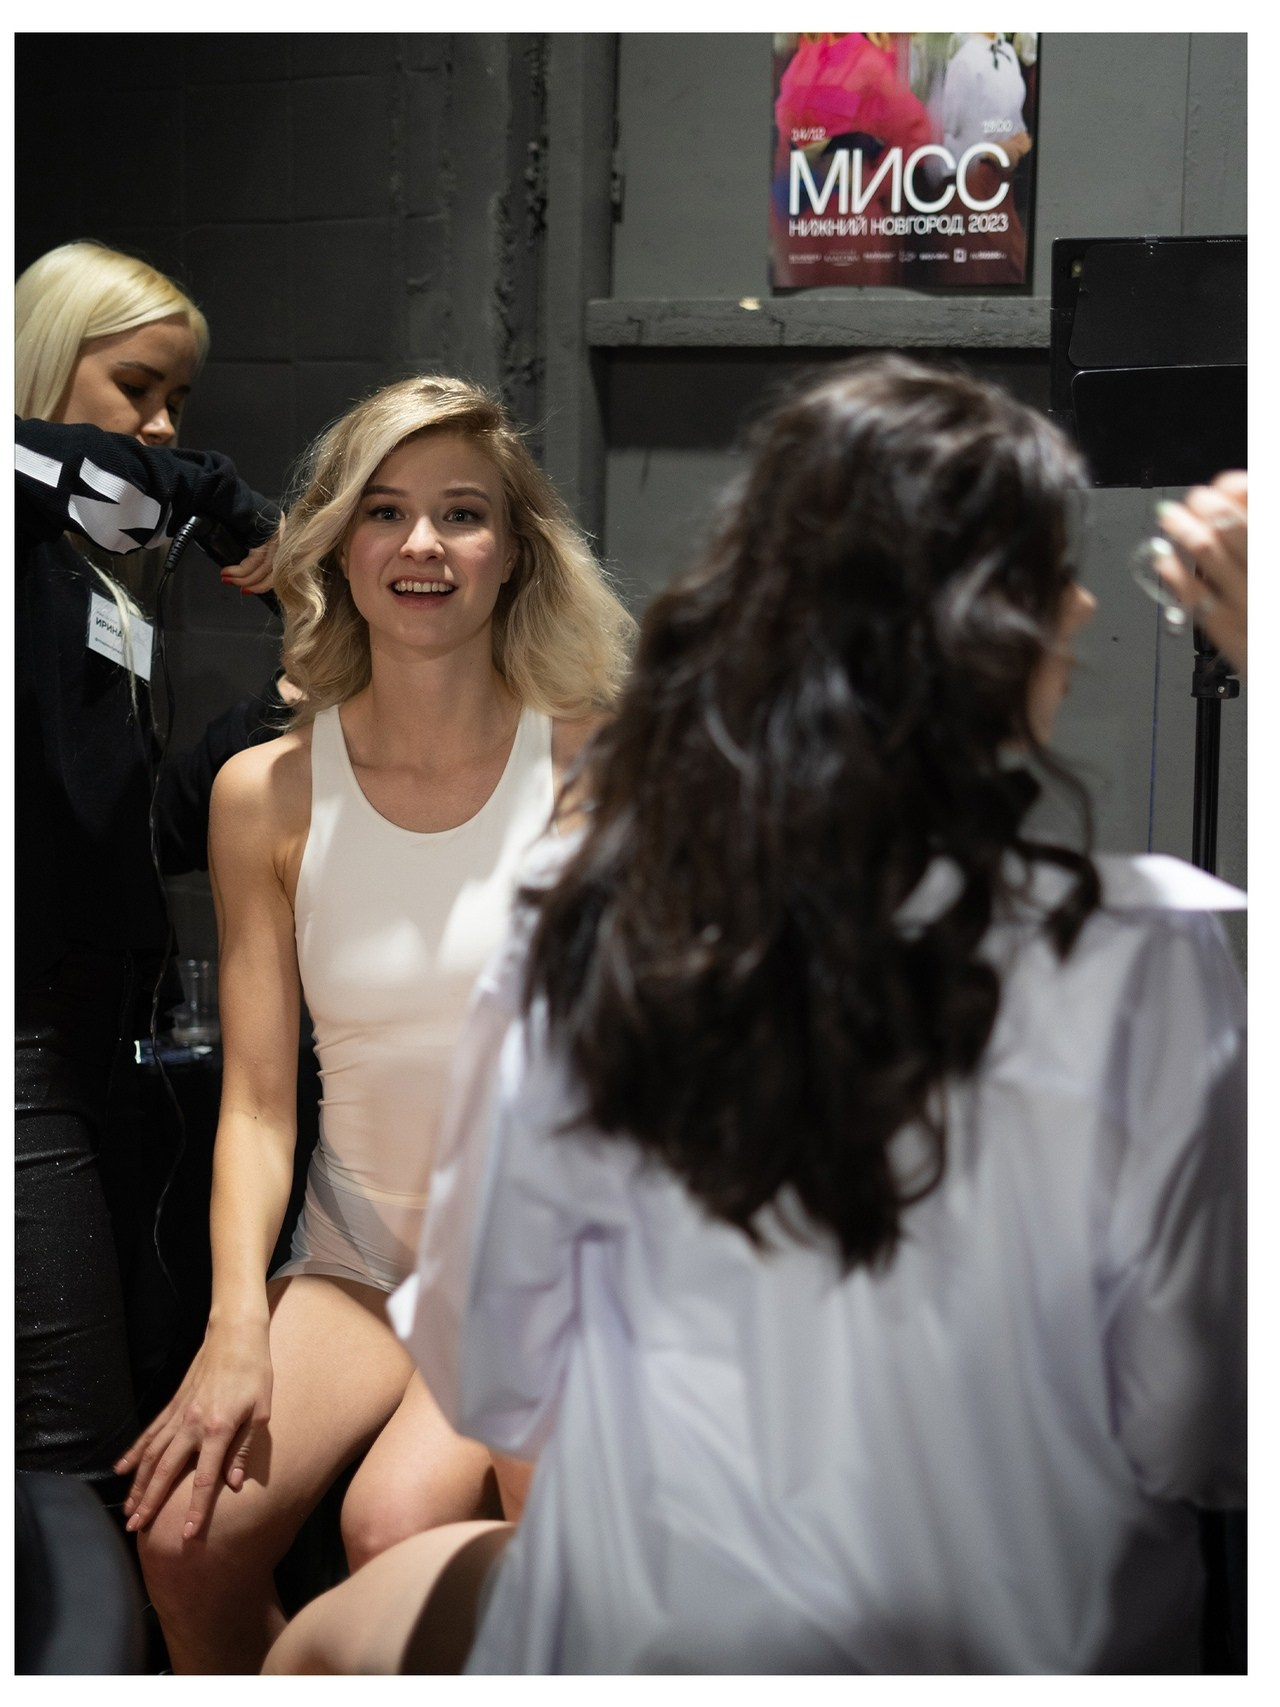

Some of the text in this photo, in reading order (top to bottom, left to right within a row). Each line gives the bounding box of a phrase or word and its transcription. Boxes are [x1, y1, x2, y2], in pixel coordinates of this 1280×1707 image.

[789, 142, 1011, 216] МИСС
[788, 213, 1010, 237] НИЖНИЙ НОВГОРОД 2023
[96, 617, 123, 638] ИРИНА
